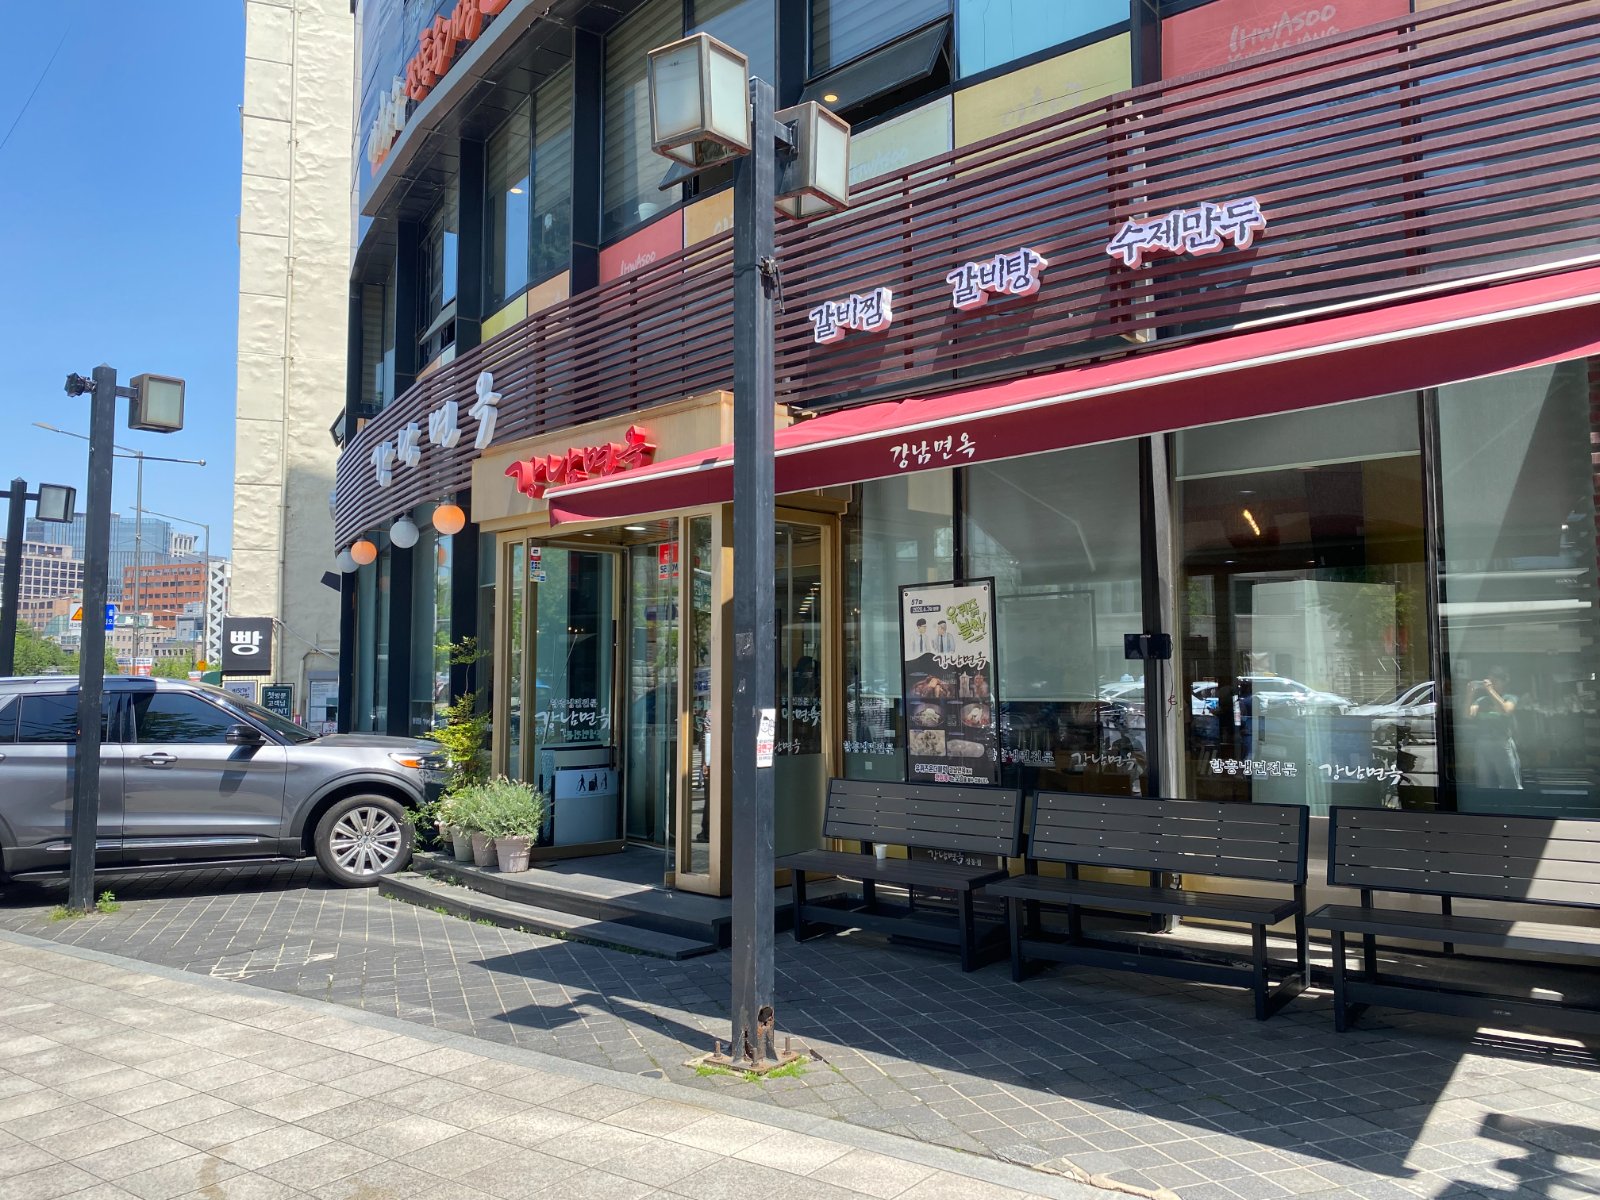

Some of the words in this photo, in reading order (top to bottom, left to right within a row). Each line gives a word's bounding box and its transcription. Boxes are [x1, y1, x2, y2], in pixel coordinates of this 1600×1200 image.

[1106, 196, 1267, 268] 수제만두
[946, 247, 1048, 311] 갈비탕
[808, 287, 892, 344] 갈비찜
[505, 425, 657, 499] 강남면옥
[890, 432, 976, 468] 강남면옥
[230, 630, 263, 656] 빵
[932, 651, 987, 670] 강남면옥
[535, 707, 610, 729] 강남면옥
[1070, 752, 1137, 772] 강남면옥
[1210, 758, 1298, 777] 함흥냉면전문
[1318, 763, 1404, 785] 강남면옥
[927, 849, 964, 865] 강남면옥
